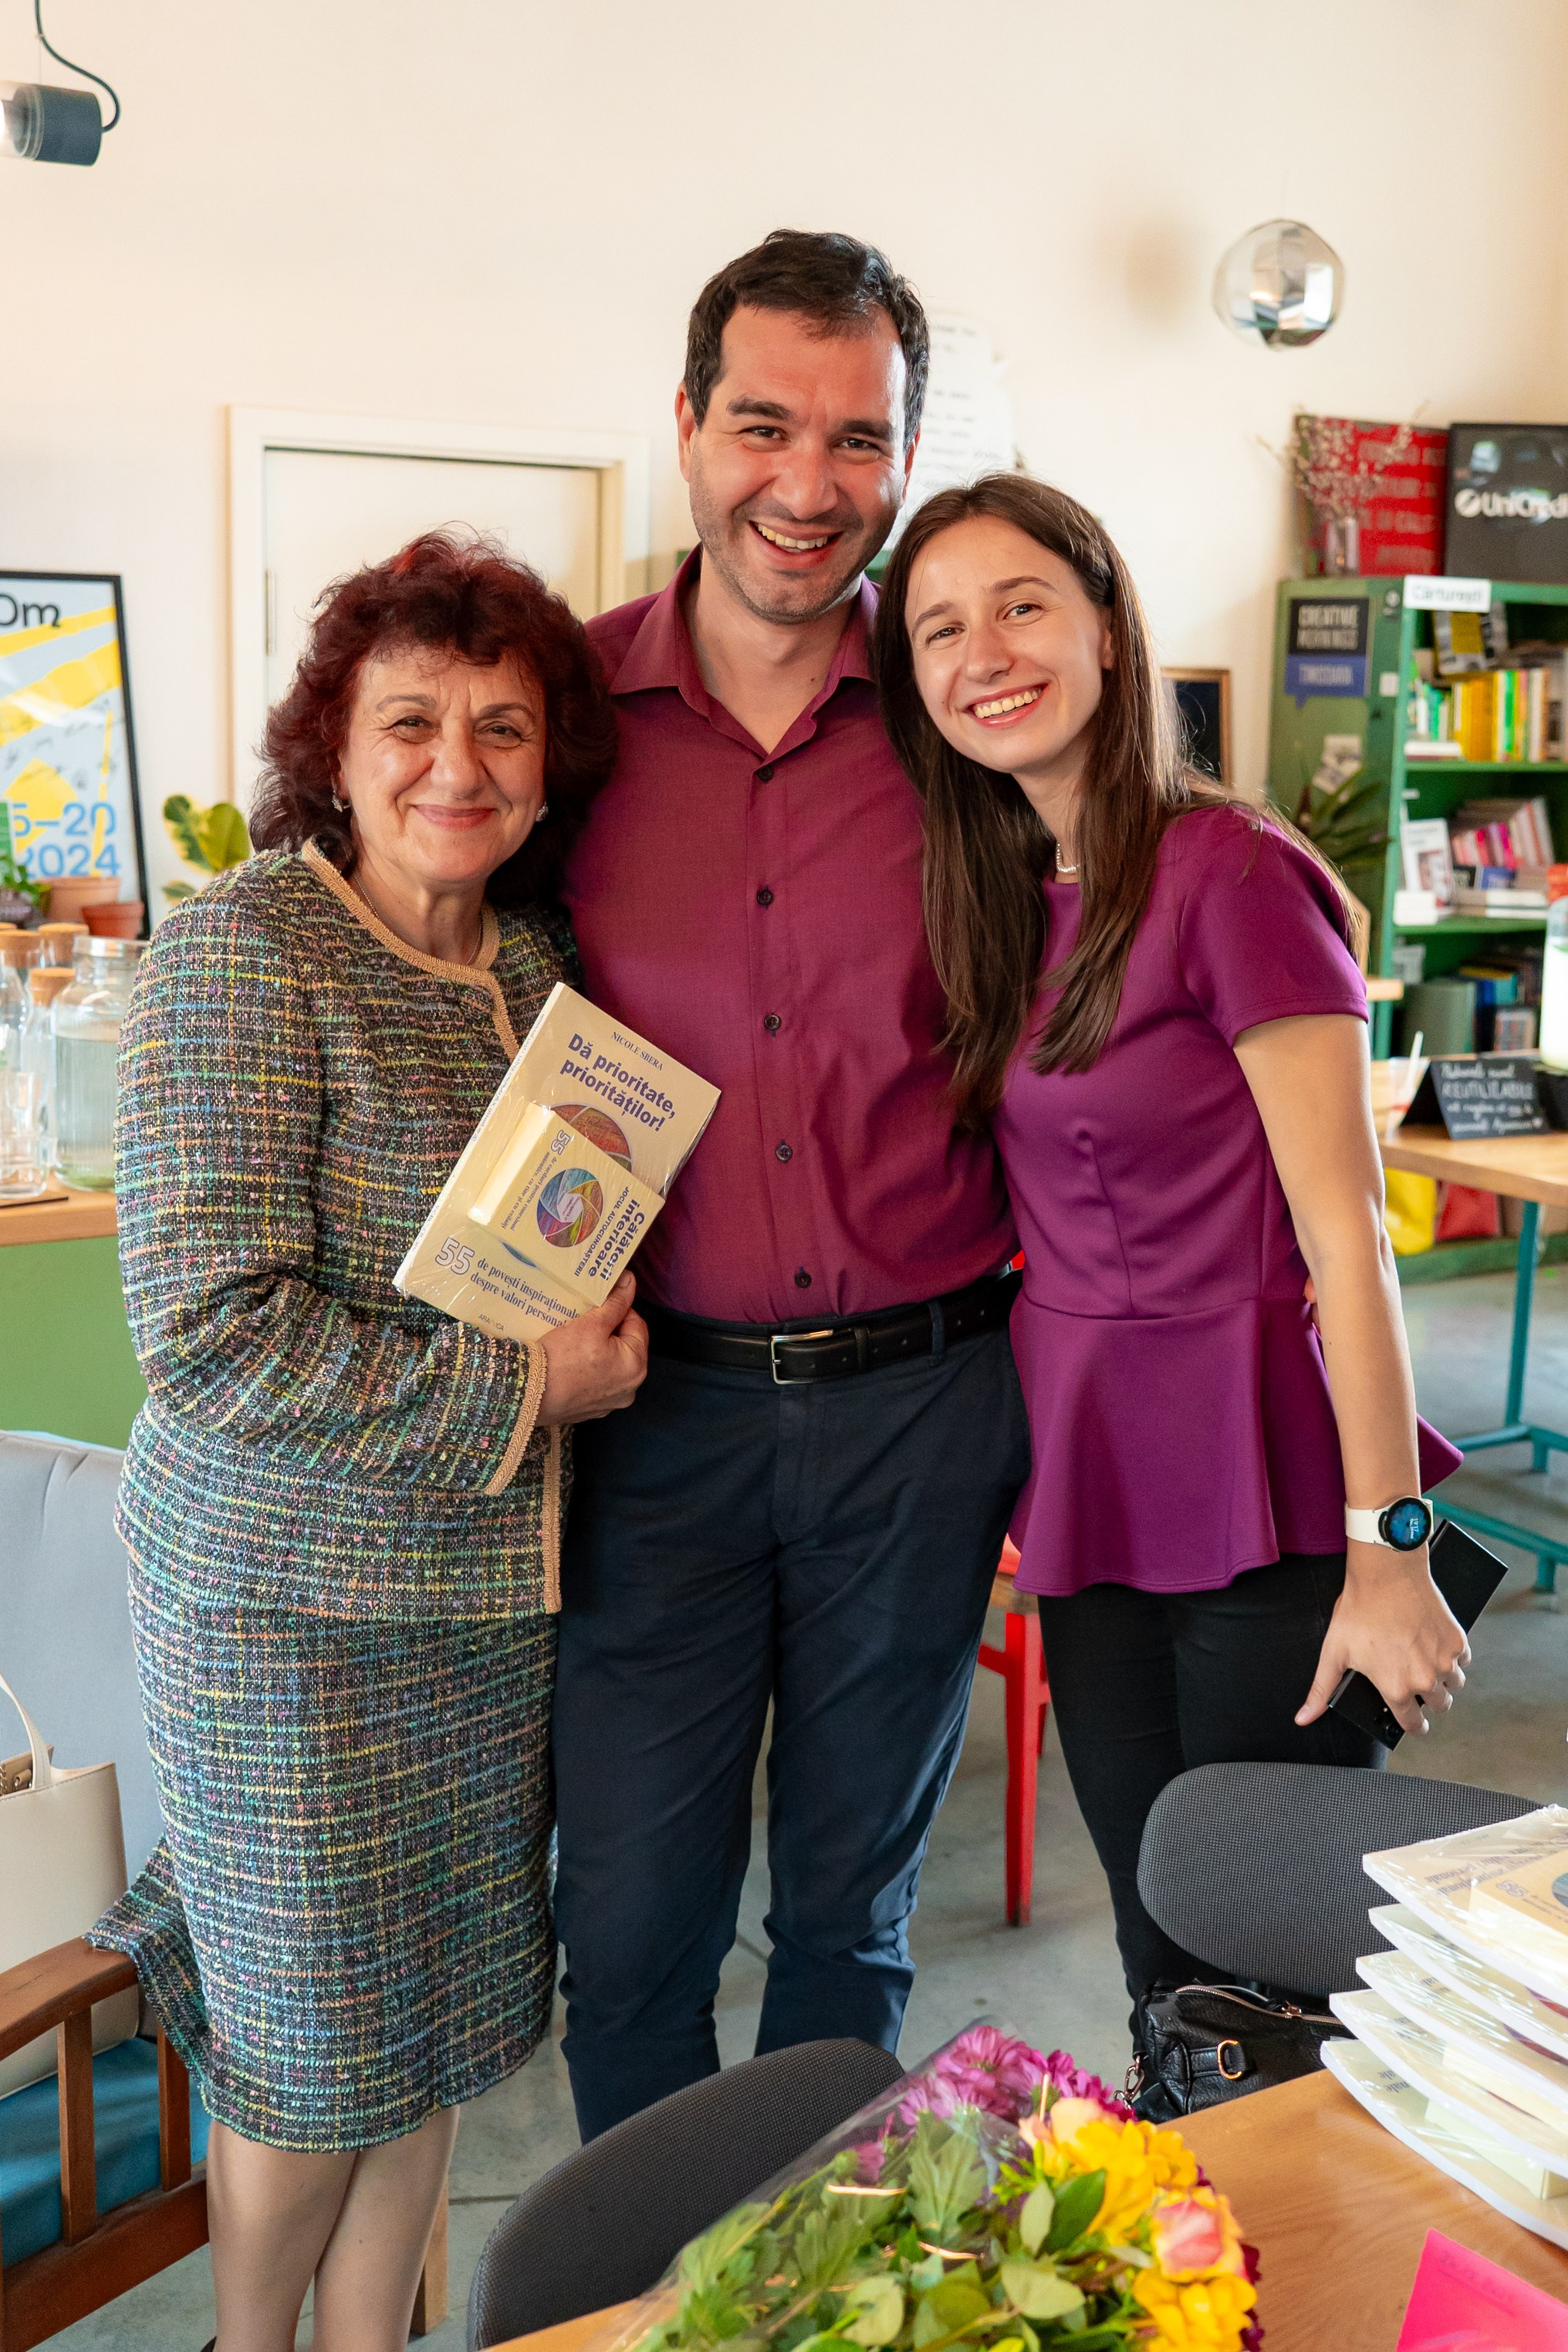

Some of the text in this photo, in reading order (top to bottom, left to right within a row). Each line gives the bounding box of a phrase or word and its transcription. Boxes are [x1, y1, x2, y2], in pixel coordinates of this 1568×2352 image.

[610, 1031, 663, 1071] NICOLE SBERA
[559, 1059, 666, 1132] priorităților!
[567, 1032, 676, 1120] Dă prioritate,
[550, 1129, 571, 1156] 55
[550, 1156, 557, 1164] de
[525, 1184, 540, 1205] pentru
[537, 1164, 553, 1186] carduri
[613, 1186, 630, 1209] JOCUL
[588, 1198, 640, 1277] interioare
[600, 1211, 645, 1281] Călătorii
[434, 1236, 476, 1276] 55
[477, 1258, 489, 1271] de
[488, 1266, 522, 1289] povești
[470, 1272, 568, 1329] despre valori persona
